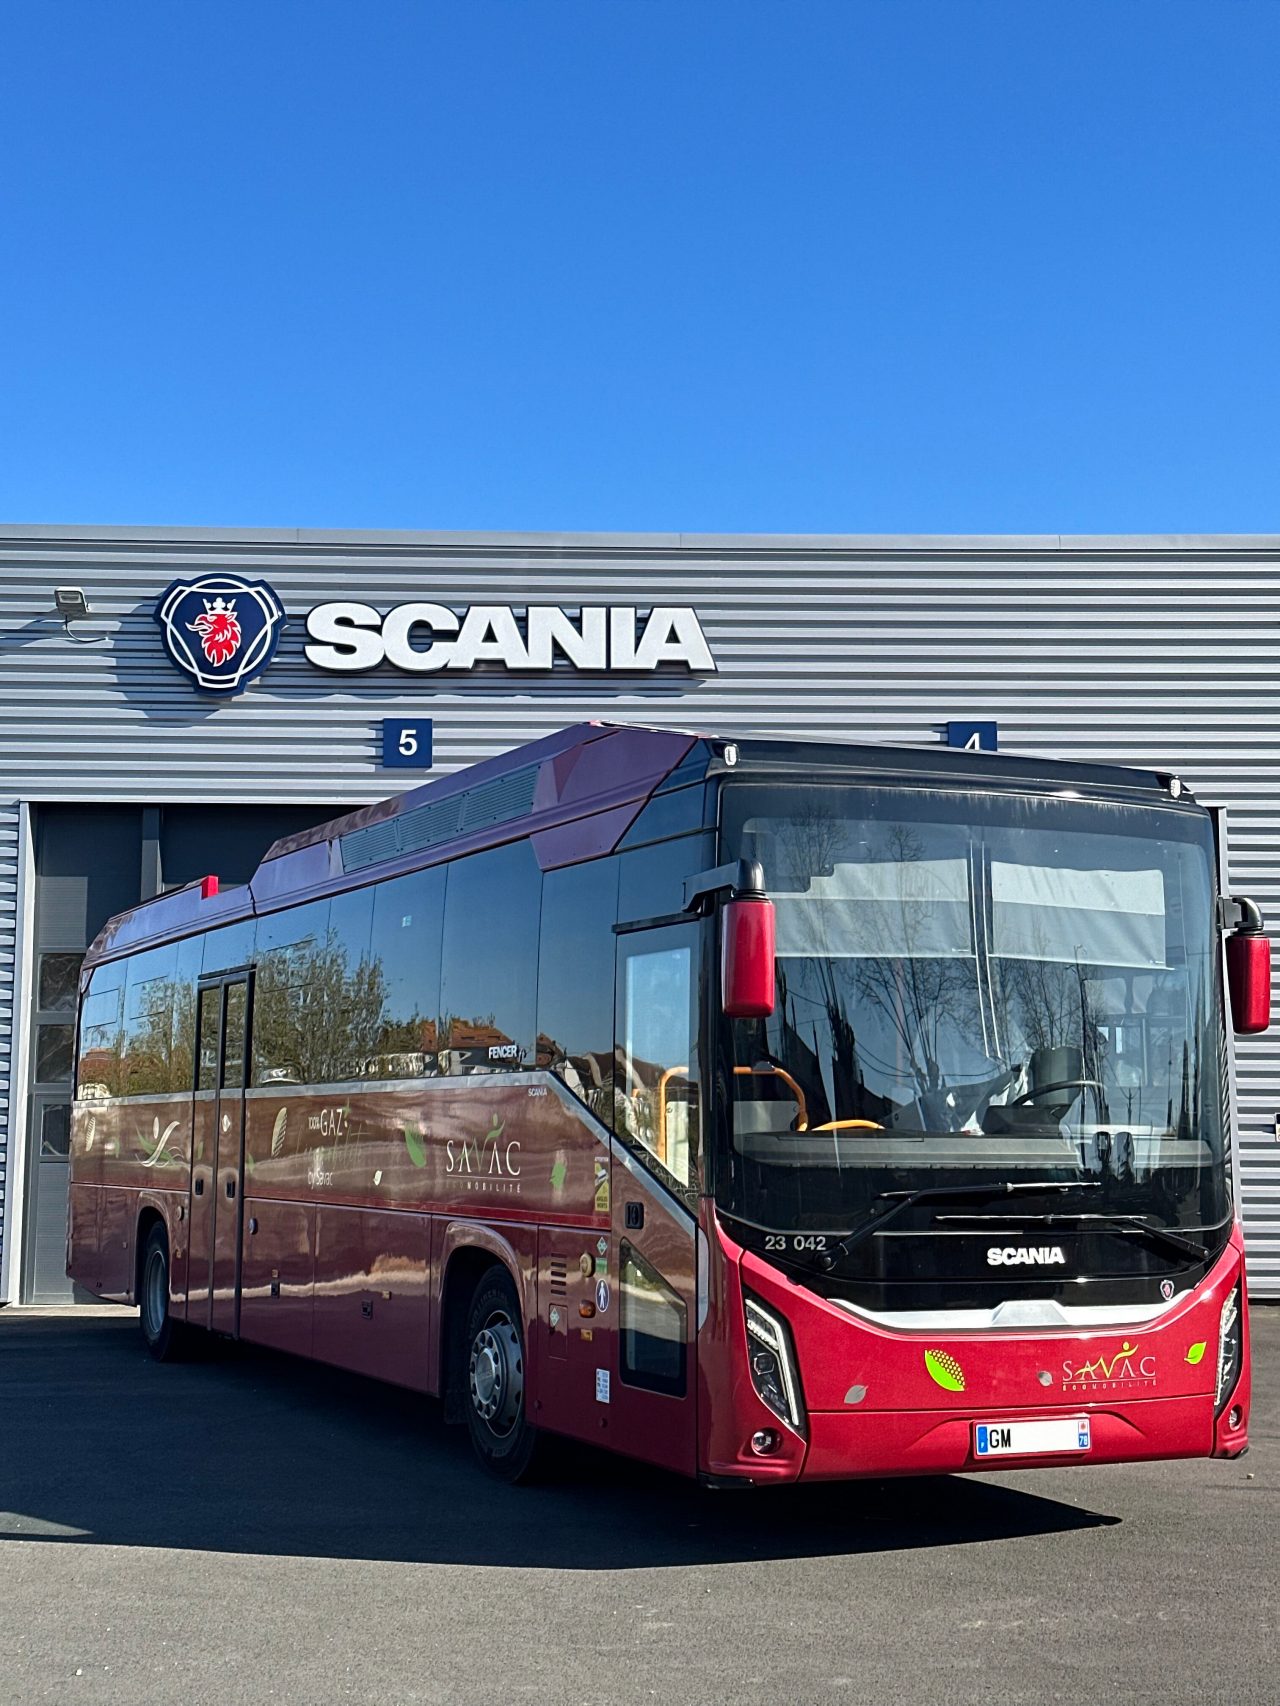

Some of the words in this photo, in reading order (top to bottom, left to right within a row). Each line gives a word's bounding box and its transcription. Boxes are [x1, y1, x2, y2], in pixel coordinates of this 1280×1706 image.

[304, 602, 716, 672] SCANIA
[398, 729, 418, 756] 5
[964, 732, 980, 751] 4
[488, 1044, 517, 1060] FENCER
[528, 1087, 548, 1097] SCANIA
[320, 1108, 343, 1136] GAZ
[446, 1136, 521, 1176] SAVAC
[446, 1181, 521, 1194] MOBILITÉ
[765, 1235, 786, 1250] 23
[793, 1236, 826, 1251] 042
[986, 1246, 1066, 1266] SCANIA
[1062, 1354, 1156, 1382] SAVAC
[989, 1428, 1011, 1449] GM
[1079, 1435, 1088, 1446] 78
